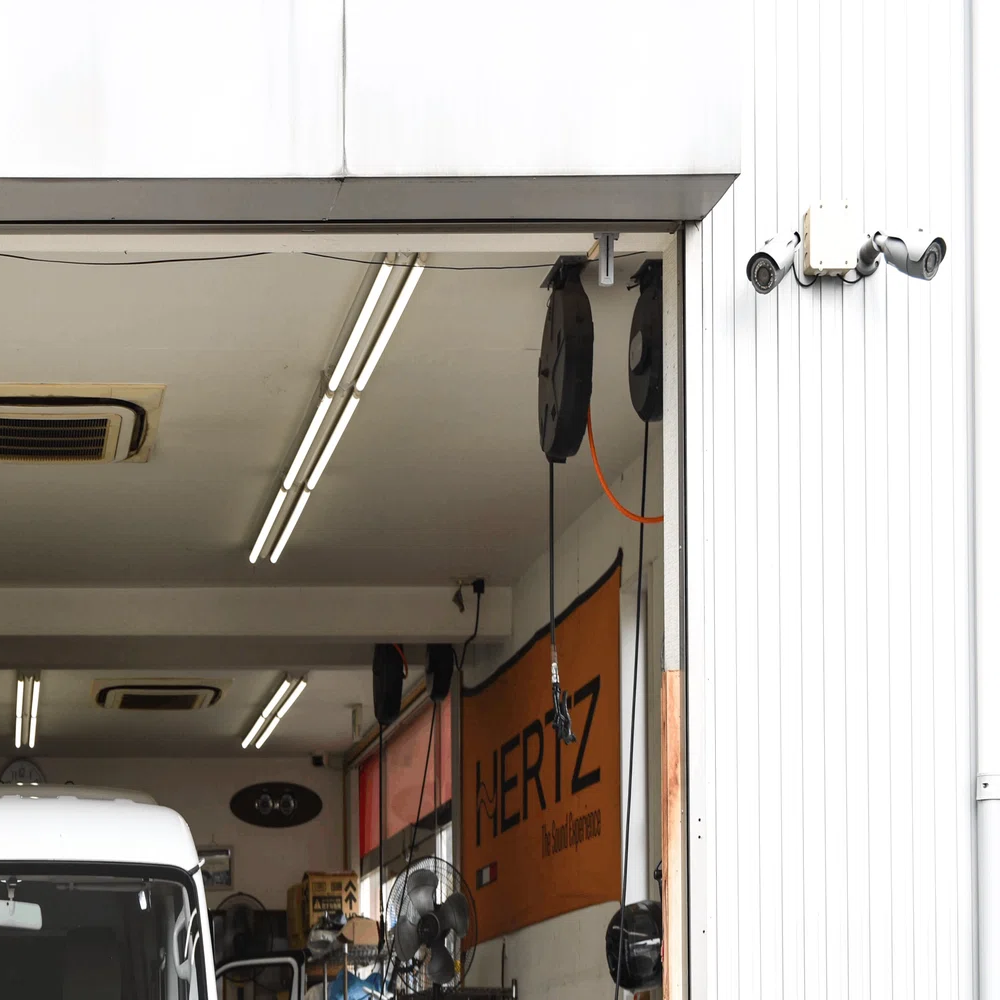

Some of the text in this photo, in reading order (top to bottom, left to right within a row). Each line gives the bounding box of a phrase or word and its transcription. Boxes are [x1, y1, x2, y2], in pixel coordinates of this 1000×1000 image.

[476, 674, 601, 847] HERTZ
[541, 810, 601, 859] The Sound Experience
